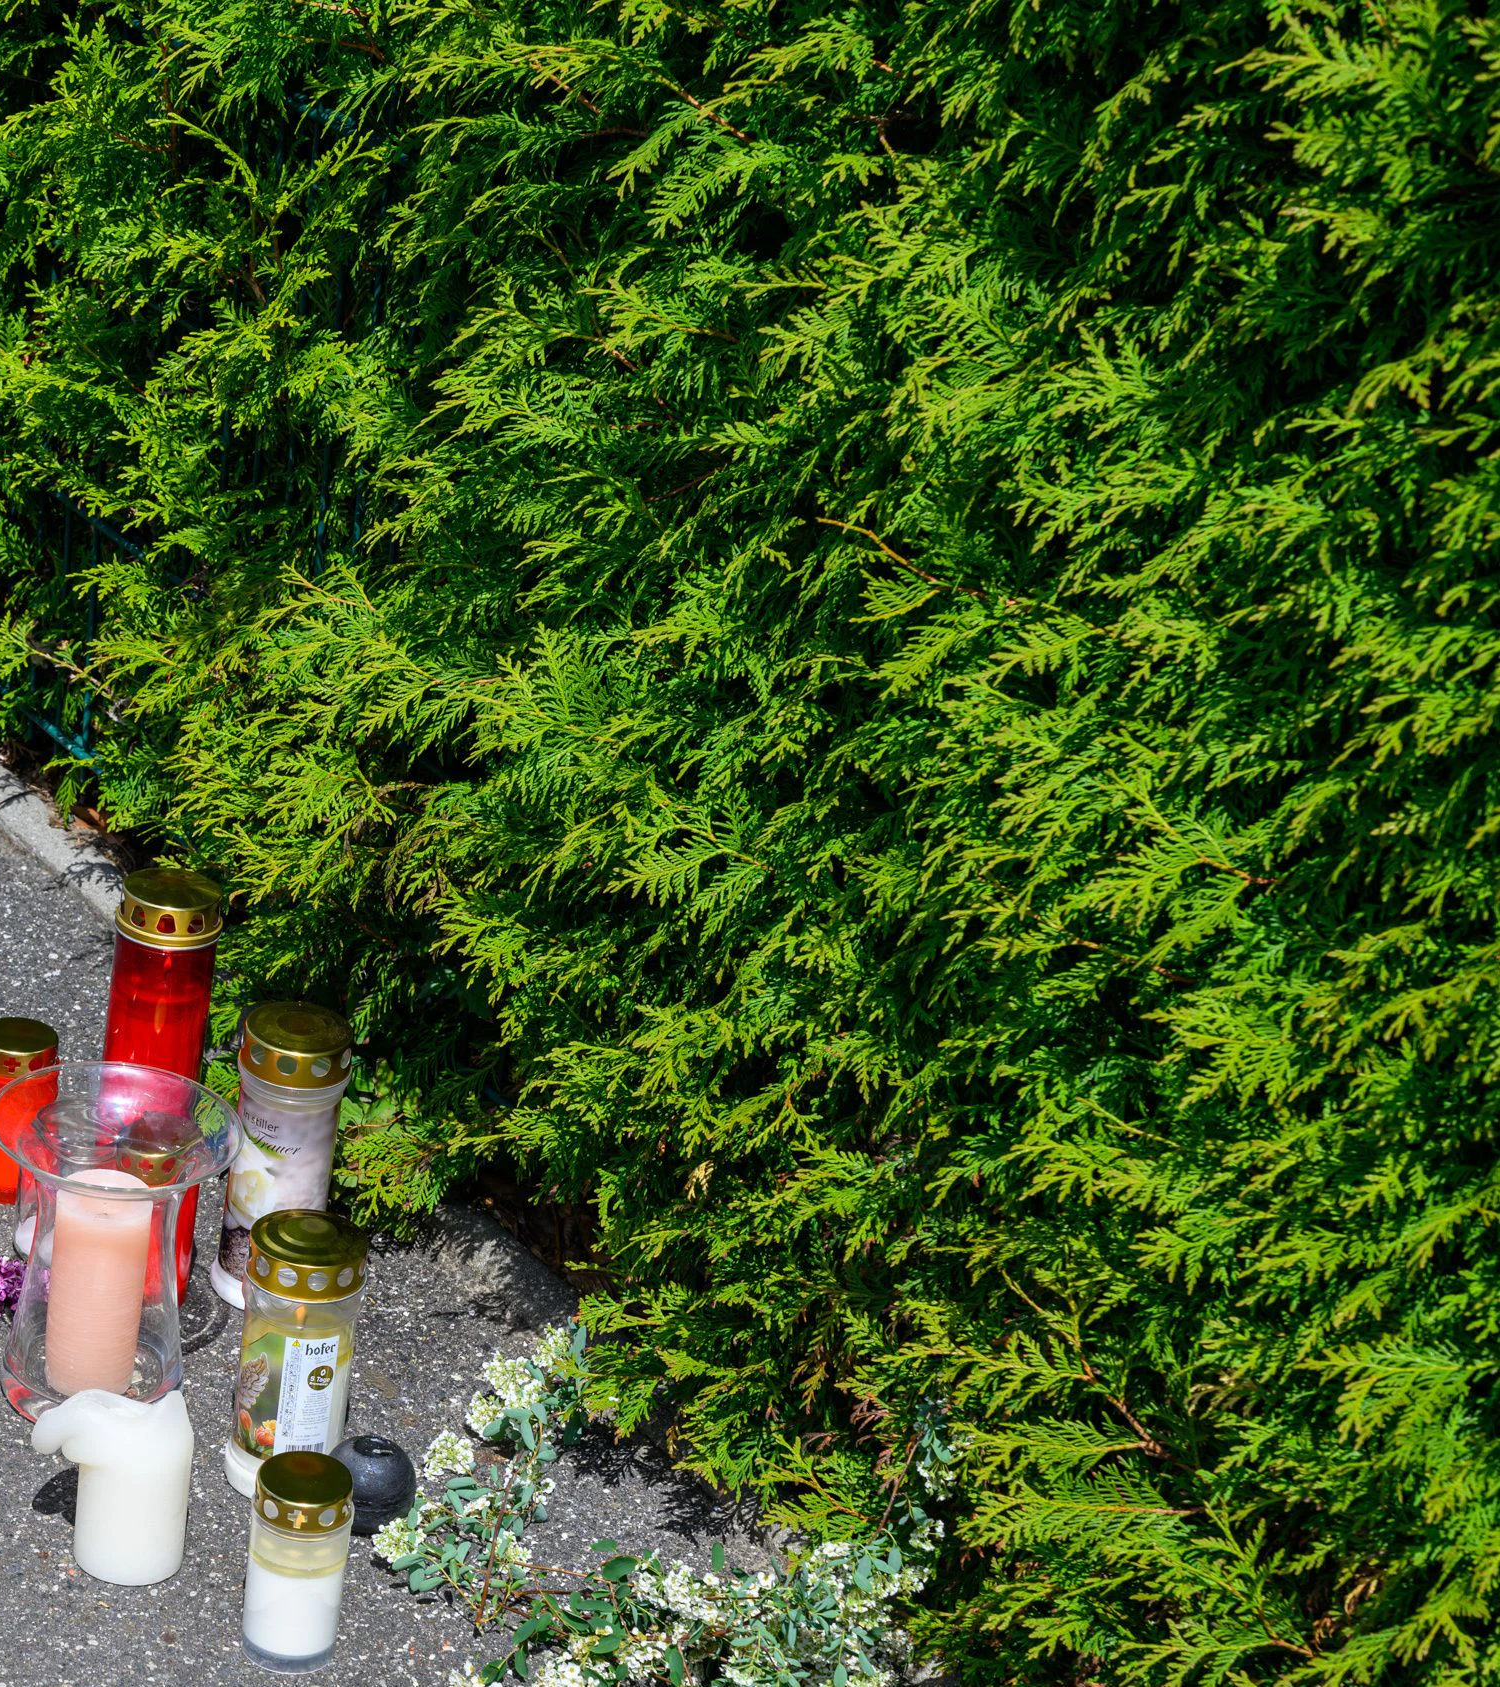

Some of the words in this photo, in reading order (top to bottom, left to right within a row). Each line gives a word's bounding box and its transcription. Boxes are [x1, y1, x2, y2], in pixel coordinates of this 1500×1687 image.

[251, 1116, 279, 1132] stiller
[253, 1130, 301, 1155] Trauer
[305, 1342, 336, 1356] hofer
